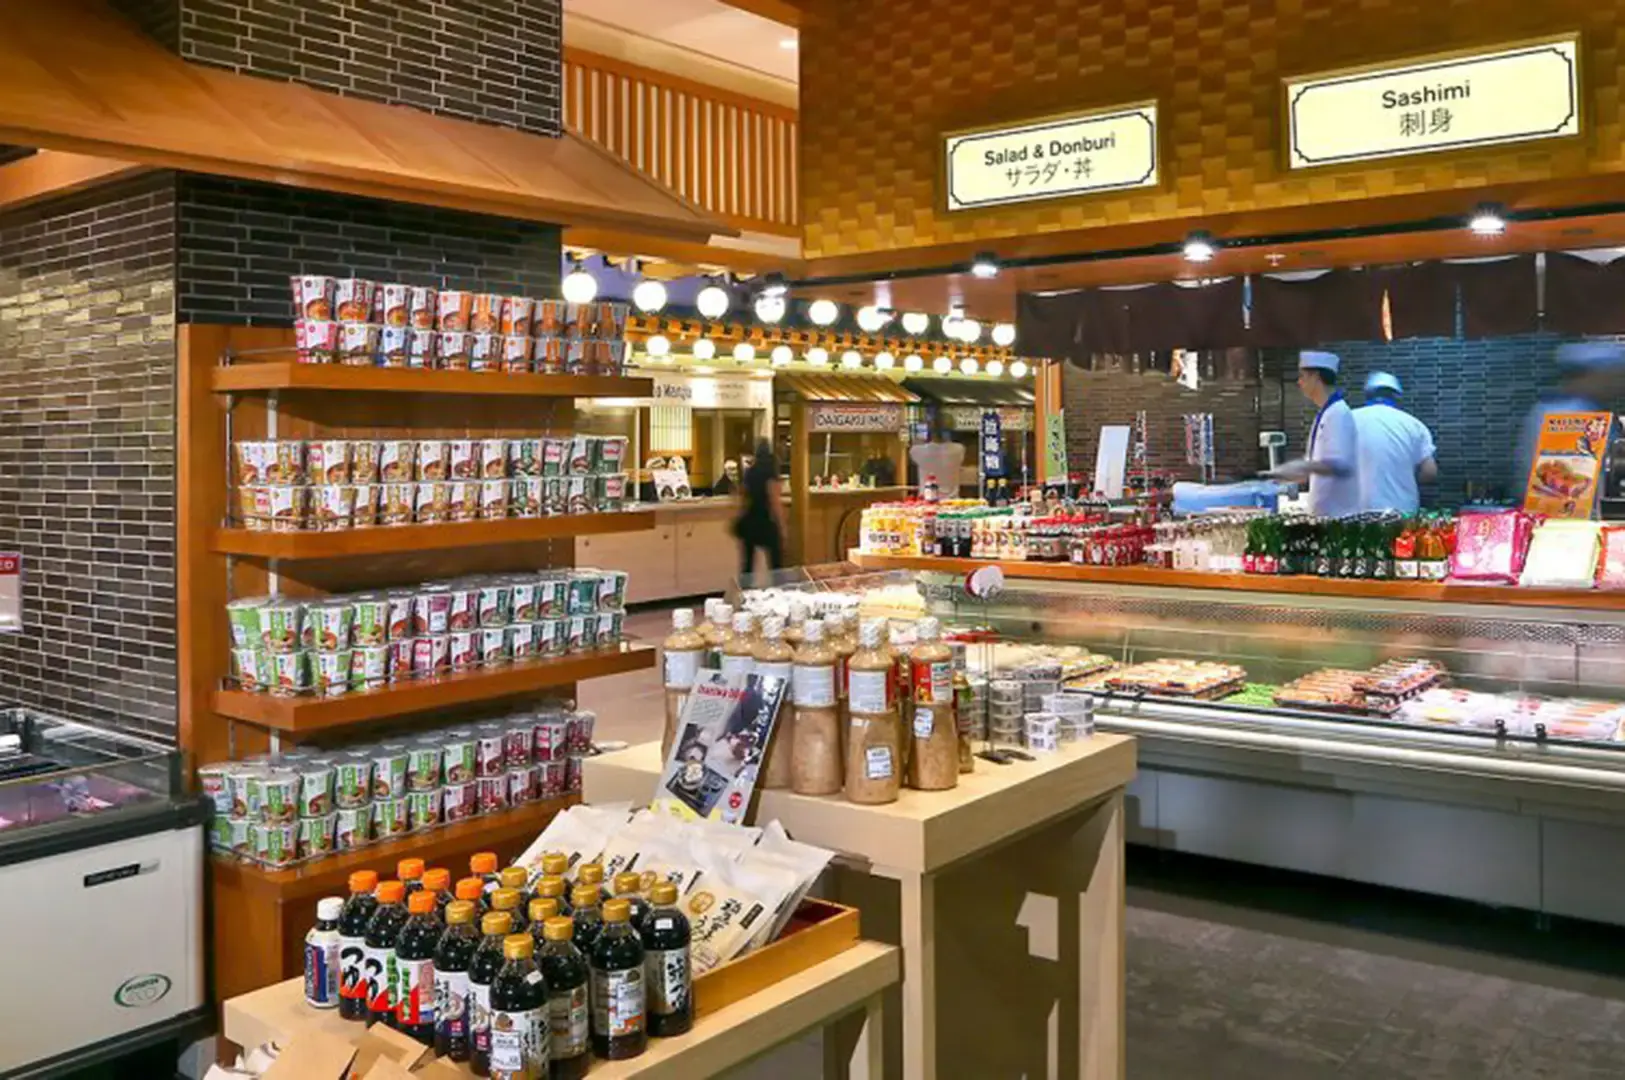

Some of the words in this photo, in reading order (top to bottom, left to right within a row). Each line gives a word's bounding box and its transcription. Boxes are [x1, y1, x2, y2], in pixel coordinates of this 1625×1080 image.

[1381, 80, 1471, 109] Sashimi
[1399, 107, 1453, 138] 刺身
[984, 145, 1028, 166] Salad
[1032, 144, 1044, 159] &
[1049, 131, 1116, 157] Donburi
[1005, 156, 1094, 187] サラダ・丼
